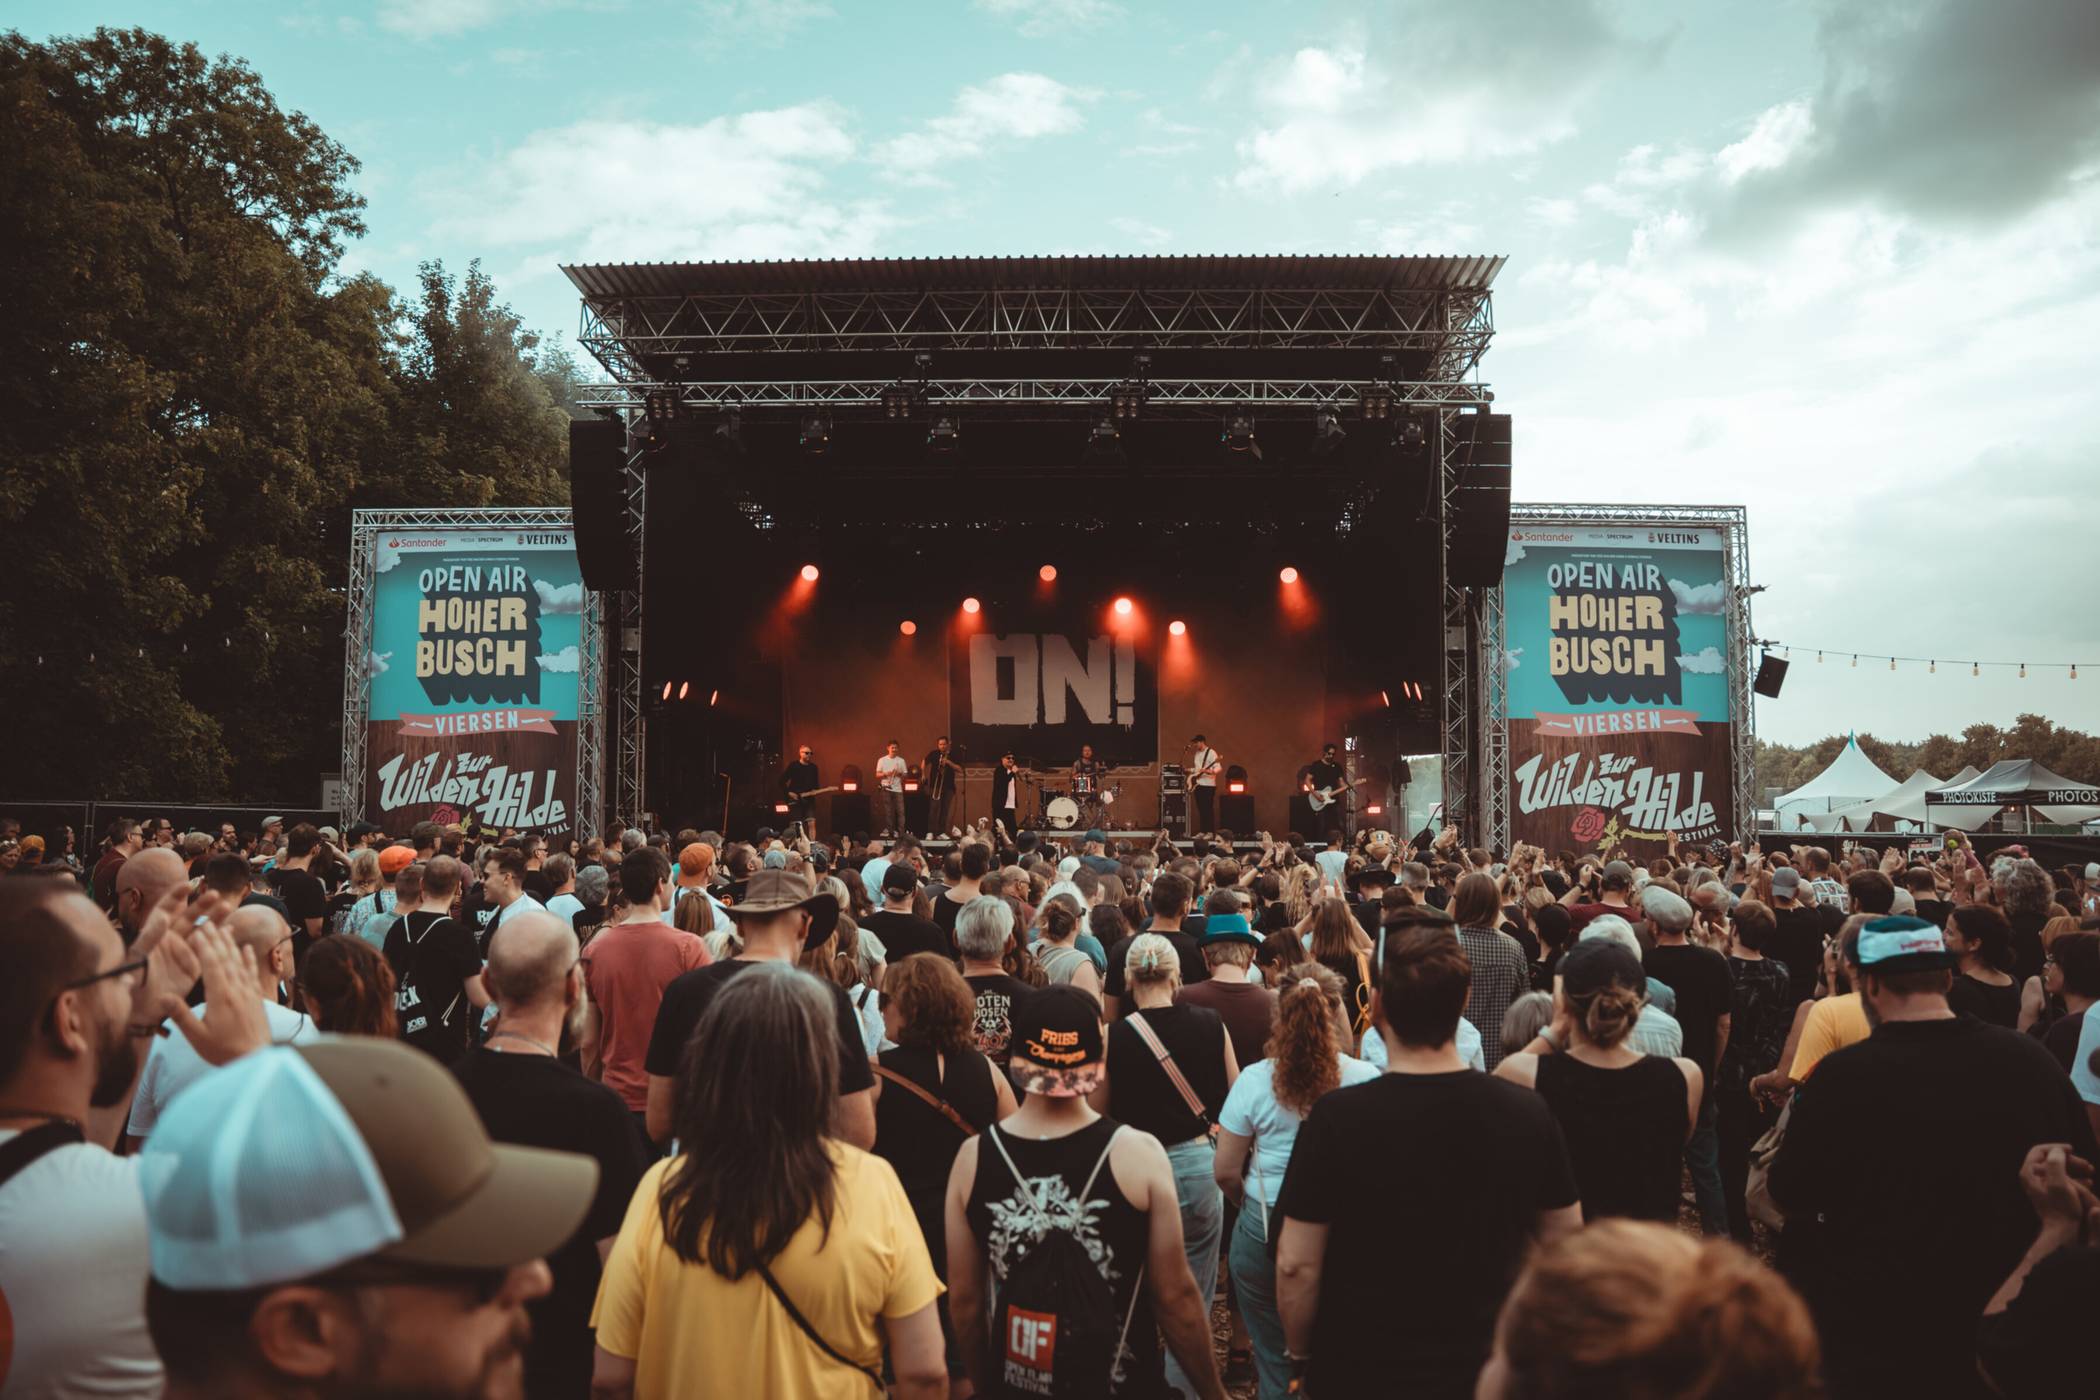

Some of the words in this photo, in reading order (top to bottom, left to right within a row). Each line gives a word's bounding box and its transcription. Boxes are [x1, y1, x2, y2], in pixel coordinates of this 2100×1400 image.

[401, 539, 447, 548] Santander
[527, 534, 568, 545] VELTINS
[1525, 532, 1573, 542] Santander
[1657, 533, 1700, 544] VELTINS
[418, 566, 481, 593] OPEN
[488, 565, 527, 592] AIR
[1547, 561, 1613, 589] OPEN
[1620, 562, 1661, 591] AIR
[418, 597, 527, 633] HOHER
[1549, 594, 1664, 632] HOHER
[416, 638, 526, 678] BUSCH
[1549, 636, 1665, 676] BUSCH
[969, 633, 1135, 732] ON!
[435, 711, 518, 734] VIERSEN
[1573, 711, 1661, 734] VIERSEN
[377, 752, 480, 812] Wilden
[1514, 752, 1625, 815] Wilden
[2048, 791, 2098, 802] PHOTOS
[1677, 825, 1721, 842] ESTIVAL
[976, 995, 1011, 1008] OTEN
